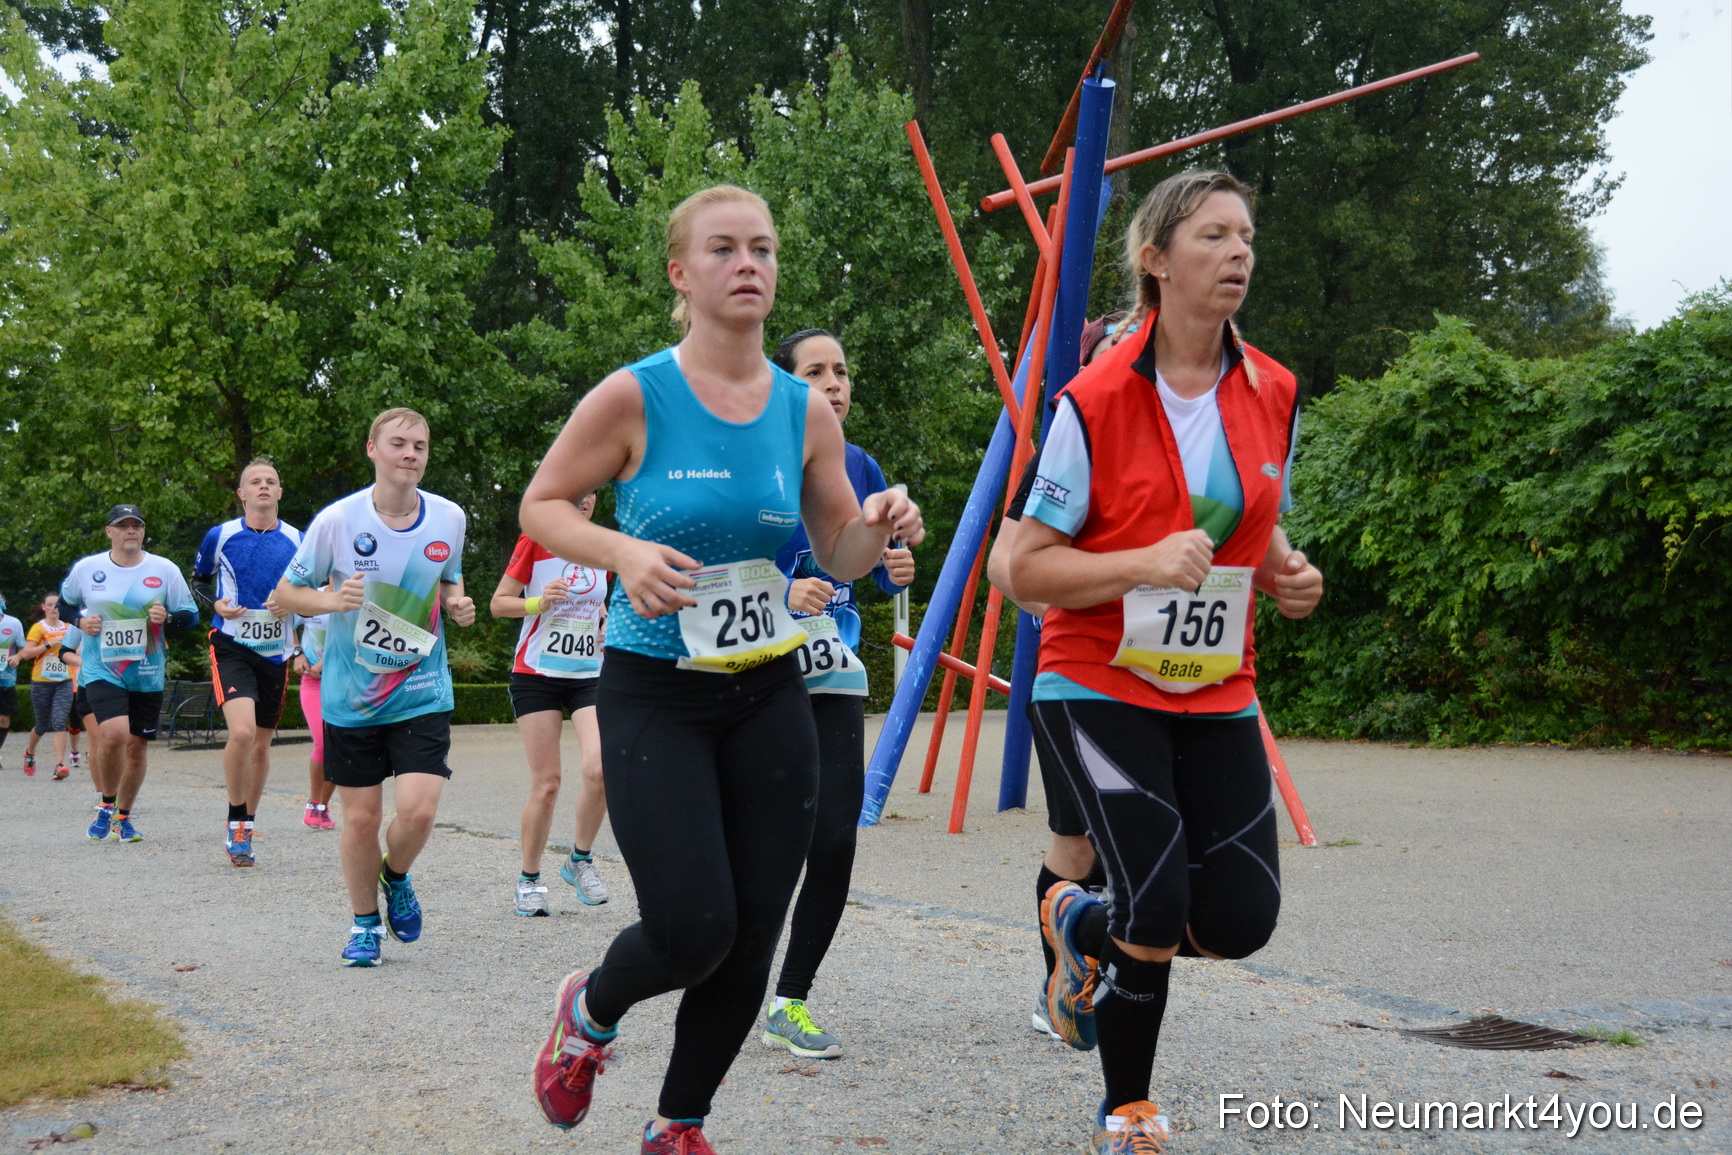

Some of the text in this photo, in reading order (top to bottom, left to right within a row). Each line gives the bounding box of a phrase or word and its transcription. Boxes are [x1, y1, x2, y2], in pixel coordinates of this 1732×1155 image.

[668, 469, 732, 479] LG Heideck
[739, 562, 781, 582] BOCK
[1201, 572, 1244, 587] OCK
[712, 592, 775, 648] 256
[799, 618, 836, 632] BOC
[1157, 600, 1227, 647] 156
[105, 629, 143, 646] 3087
[241, 621, 282, 640] 2058
[393, 619, 429, 644] BOCK
[547, 631, 594, 656] 2048
[45, 662, 67, 673] 2683
[375, 653, 410, 666] Tobias
[1159, 659, 1202, 678] Beate
[404, 679, 436, 692] Stadtlauf
